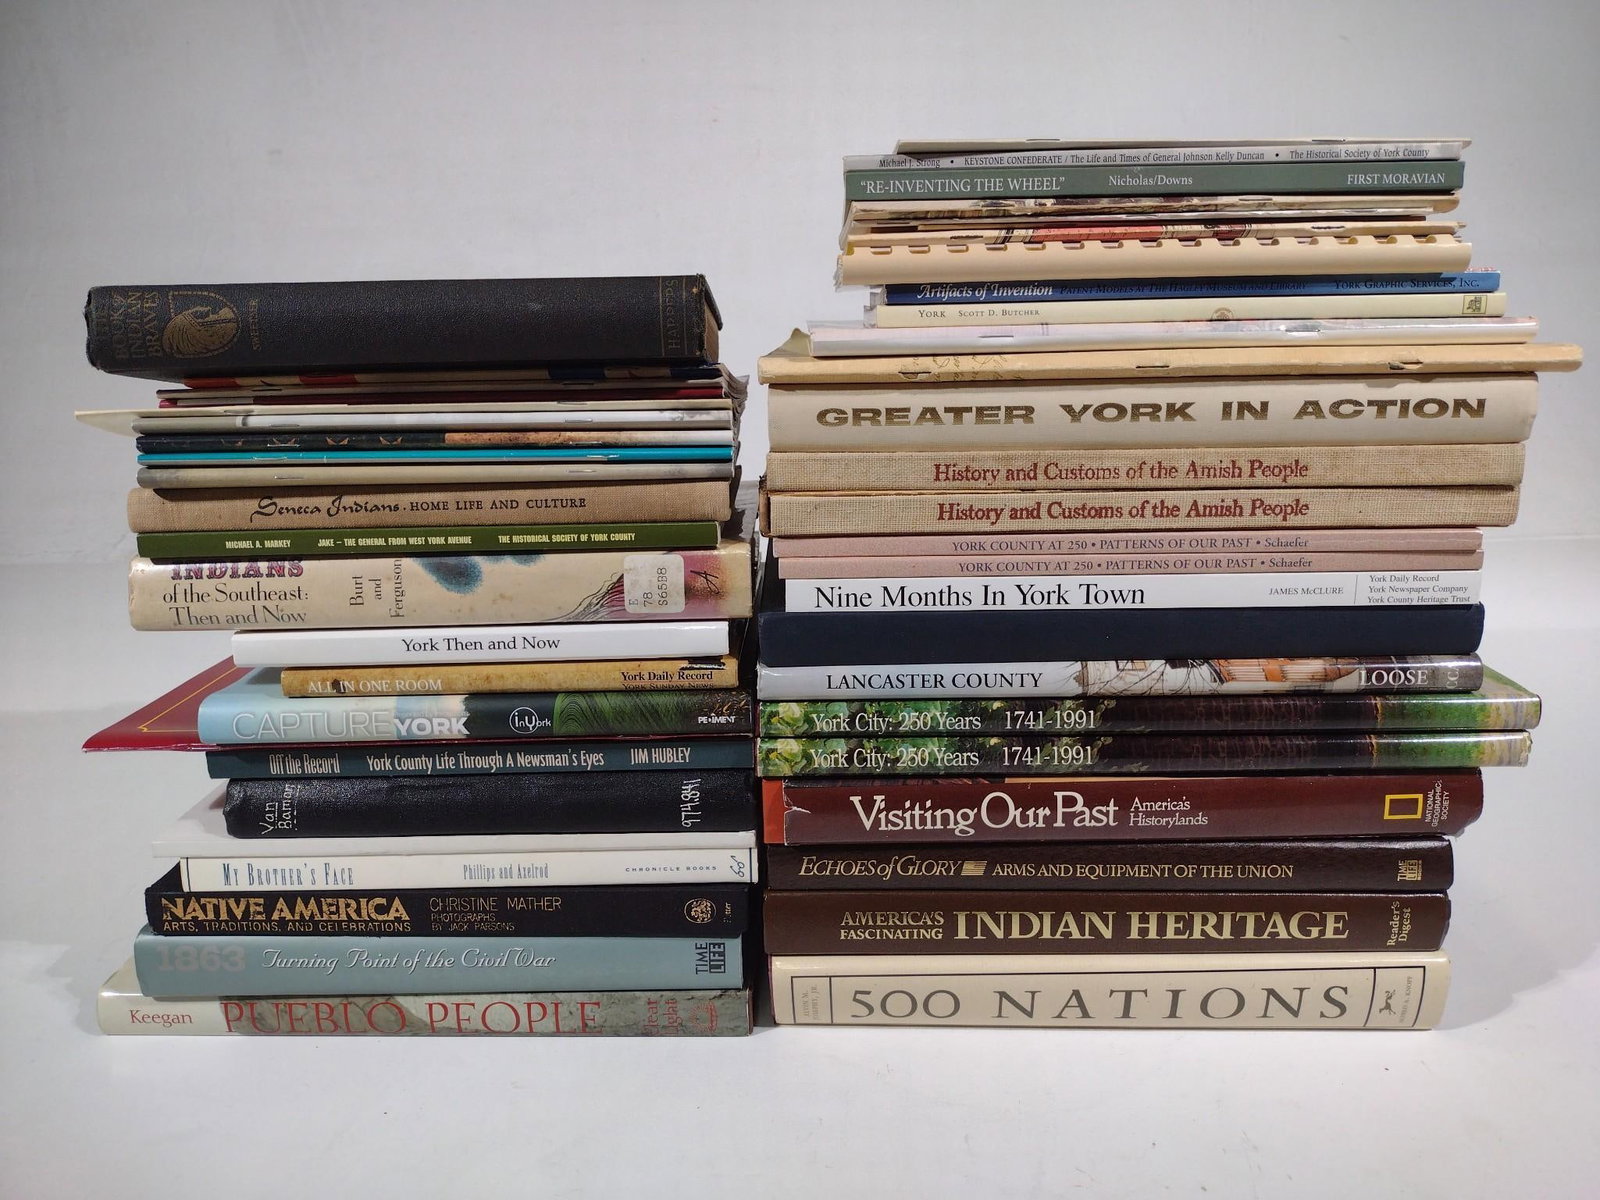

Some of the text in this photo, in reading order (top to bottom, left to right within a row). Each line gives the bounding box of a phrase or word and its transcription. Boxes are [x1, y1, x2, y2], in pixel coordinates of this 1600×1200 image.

[879, 157, 907, 168] Michael
[916, 156, 941, 169] Strong
[964, 155, 1004, 166] KEYSTONE
[1006, 154, 1062, 165] CONFEDERATE
[1070, 153, 1084, 164] The
[1086, 153, 1100, 163] Life
[1102, 152, 1117, 163] and
[1120, 152, 1141, 162] Times
[1143, 152, 1152, 162] of
[1152, 152, 1181, 162] General
[1183, 151, 1214, 162] Johnson
[1216, 151, 1234, 162] Kelly
[1236, 151, 1264, 160] Duncan
[1290, 150, 1304, 159] The
[1306, 150, 1342, 159] Historical
[1344, 149, 1372, 160] Society
[1374, 148, 1382, 158] of
[1384, 148, 1400, 158] York
[1402, 148, 1430, 159] County
[974, 178, 1004, 192] THE
[1109, 174, 1192, 187] Nicholas/Downs
[1348, 174, 1380, 185] FIRST
[1382, 173, 1445, 184] MORAVIAN
[917, 282, 1052, 300] Artifacts of Invention
[918, 310, 946, 318] YORK
[988, 309, 998, 317] D.
[816, 398, 1487, 427] GREATER YORK IN ACTION
[933, 459, 1309, 486] History and Customs of the Amish People
[250, 495, 587, 523] Seneca Indians HOME LIFE AND CULTURE
[226, 540, 291, 548] MICHAEL A. MARKEY
[171, 560, 304, 580] INDIANS
[164, 582, 309, 604] of the Southeast:
[350, 576, 364, 607] Burt
[368, 578, 382, 600] and
[388, 559, 405, 618] Ferguson
[642, 592, 653, 607] 78
[816, 583, 1145, 608] Nine Months In York Town
[1269, 586, 1344, 596] JAMES McCLURE
[1367, 594, 1470, 606] York County Heritage Trust
[1368, 584, 1468, 596] York Newspaper Company
[629, 598, 639, 606] E
[169, 604, 307, 626] Then and Now
[402, 636, 560, 652] York Then and Now
[826, 670, 1428, 690] LANCASTER COUNTY LOOSE
[232, 711, 470, 740] CAPTURE YORK
[812, 710, 1096, 734] York City: 250 Years 1741-1991
[269, 748, 690, 774] Off the Record York County Life Through A Newsman's Eyes JIM HUBLEY
[681, 778, 701, 827] 974.841
[849, 791, 1118, 836] Visiting Our Past
[1130, 796, 1191, 811] America's
[1425, 789, 1434, 822] NATIONAL
[1432, 782, 1442, 827] GEOGRAPHIC
[1440, 791, 1450, 820] SOCIETY
[1128, 812, 1208, 828] Historylands
[798, 855, 1294, 880] ECHOES of GLORY ARMS AND EQUIPMENT OF THE UNION
[161, 896, 410, 920] NATIVE AMERICA
[430, 897, 561, 912] CHRISTINE MATHER
[840, 911, 944, 926] AMERICA'S
[953, 911, 1349, 940] INDIAN HERITAGE
[1387, 901, 1400, 946] Reader's
[1399, 907, 1412, 942] Digest
[840, 928, 944, 940] FASCINATING
[158, 946, 556, 975] 1863 Turning Point of the Civil War
[695, 942, 708, 976] TIME
[708, 942, 726, 974] LIFE
[851, 990, 961, 1019] 500
[991, 986, 1348, 1019] NATIONS
[130, 1001, 602, 1034] Keegan PUEBLO PEOPLE
